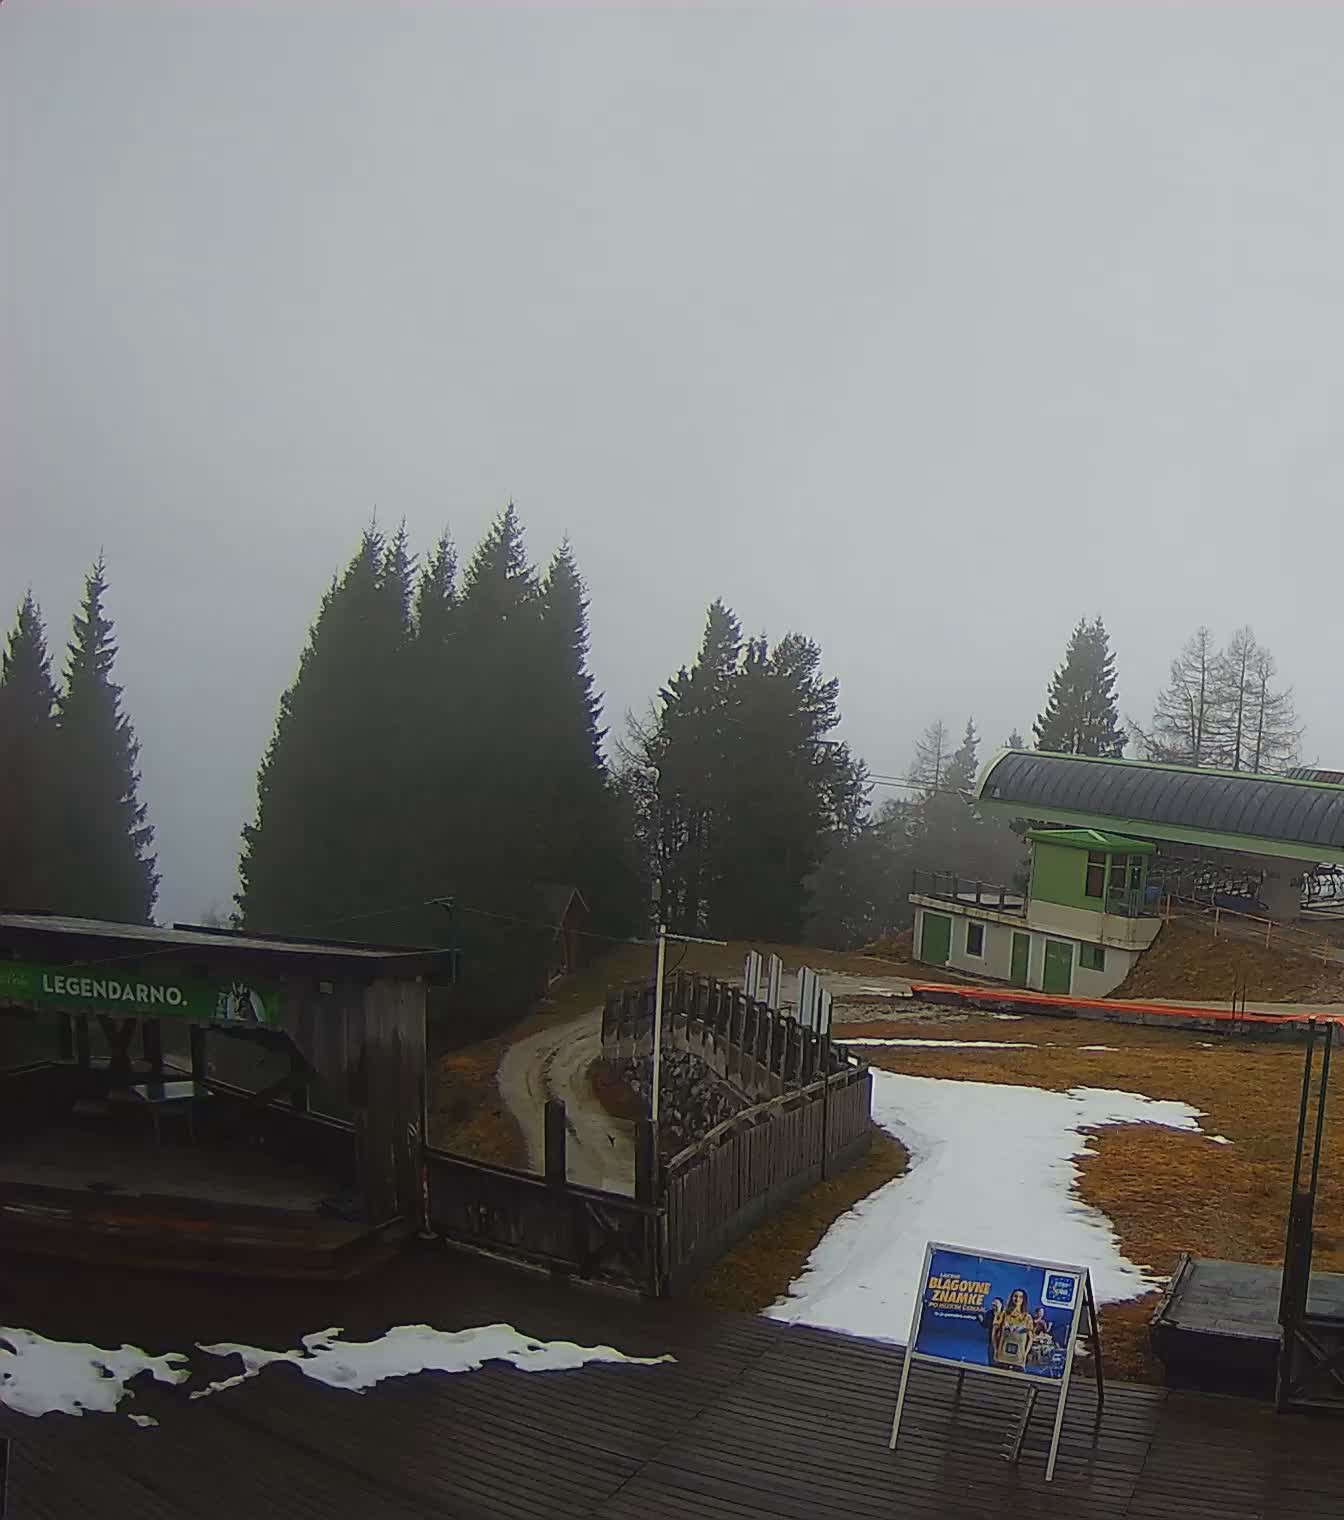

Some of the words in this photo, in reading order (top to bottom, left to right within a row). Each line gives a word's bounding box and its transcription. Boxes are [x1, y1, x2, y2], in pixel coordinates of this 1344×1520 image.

[43, 974, 188, 1005] LEGENDARNO.
[929, 1277, 991, 1294] BLAGOVNE
[931, 1290, 985, 1305] ZNAMKE
